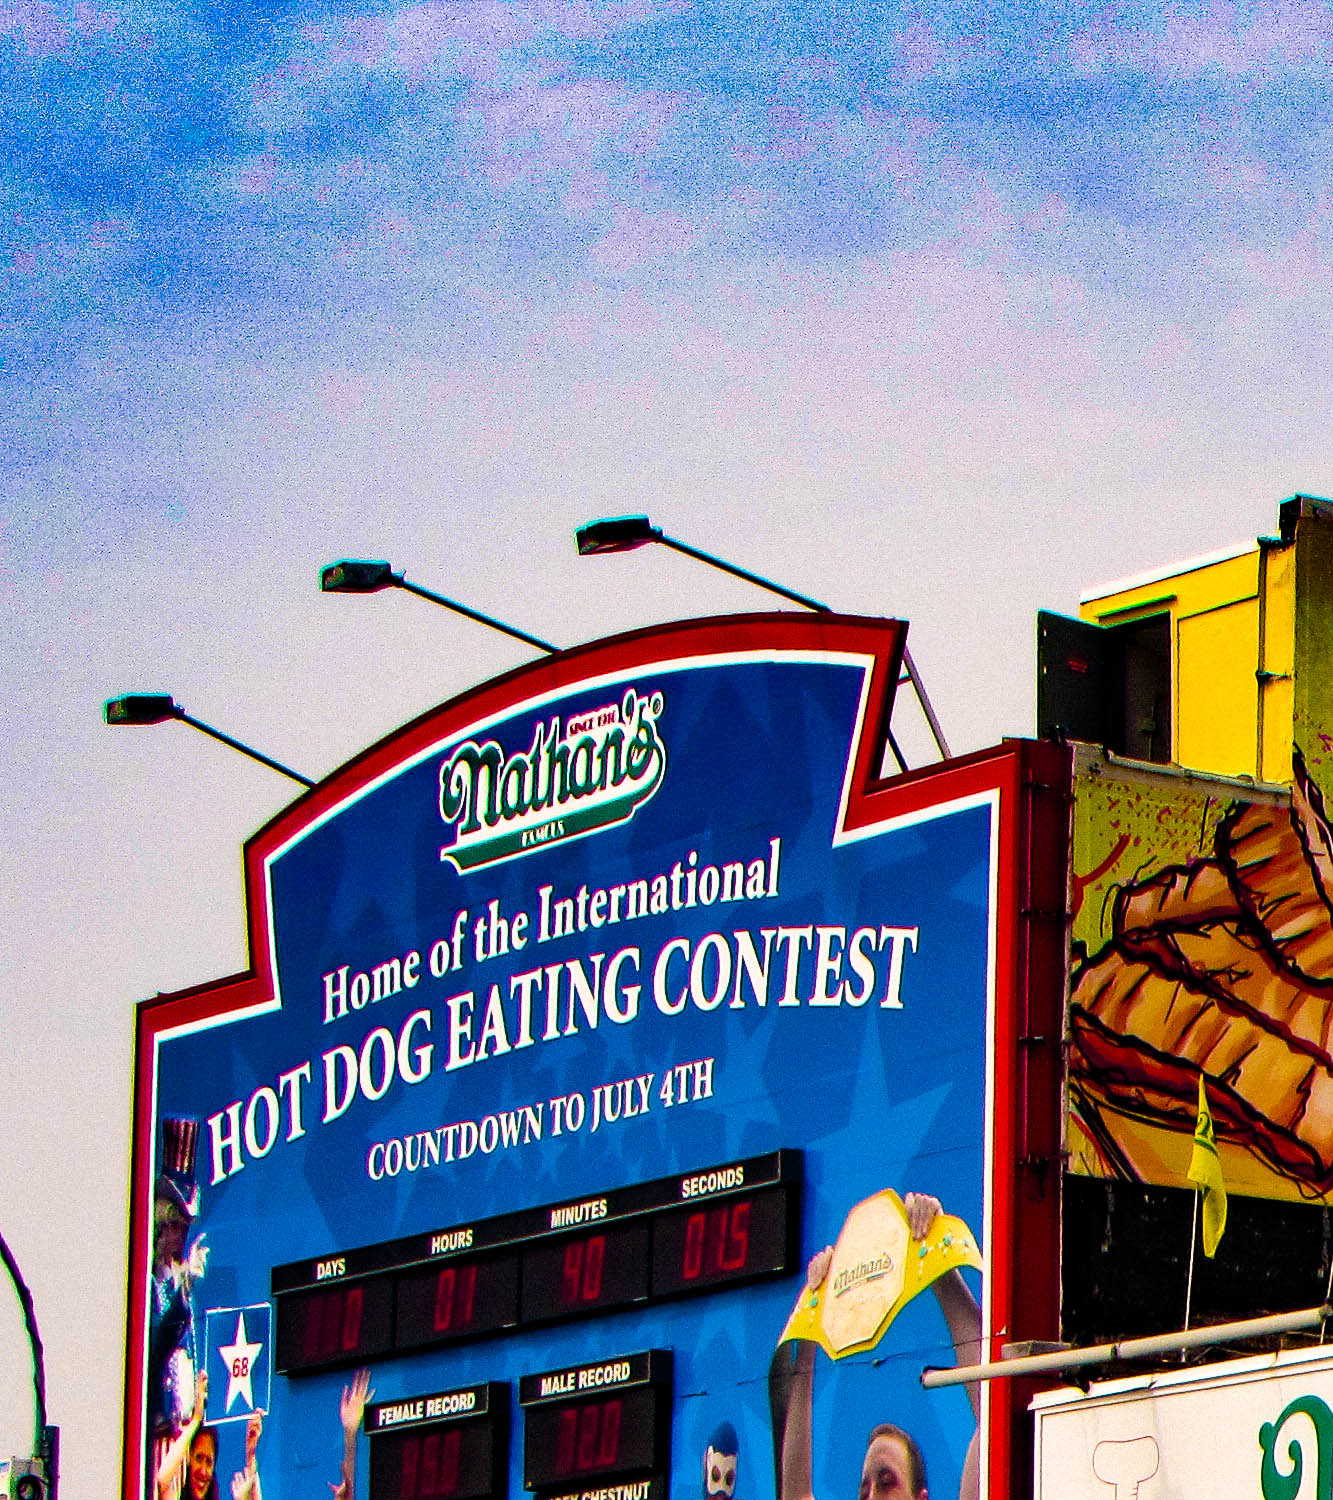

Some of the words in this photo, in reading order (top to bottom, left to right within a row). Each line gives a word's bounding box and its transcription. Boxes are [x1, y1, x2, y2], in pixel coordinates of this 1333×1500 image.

[440, 689, 666, 835] Nathan's
[322, 970, 421, 1026] Home
[430, 919, 469, 980] of
[474, 901, 527, 961] the
[538, 838, 783, 940] International
[206, 1060, 312, 1186] HOT
[322, 1014, 435, 1127] DOG
[445, 945, 642, 1074] EATING
[653, 925, 921, 1016] CONTEST
[367, 1105, 544, 1182] COUNTDOWN
[550, 1092, 587, 1134] TO
[590, 1074, 656, 1134] JULY
[660, 1058, 716, 1110] 4TH
[681, 1167, 745, 1199] SECONDS
[550, 1199, 608, 1229] MINUTES
[431, 1228, 474, 1255] HOURS
[316, 1257, 347, 1281] DAYS
[232, 1357, 249, 1378] 68
[540, 1372, 576, 1397] MALE
[578, 1361, 632, 1389] RECORD
[378, 1399, 423, 1427] FEMALE
[426, 1391, 476, 1418] RECORD
